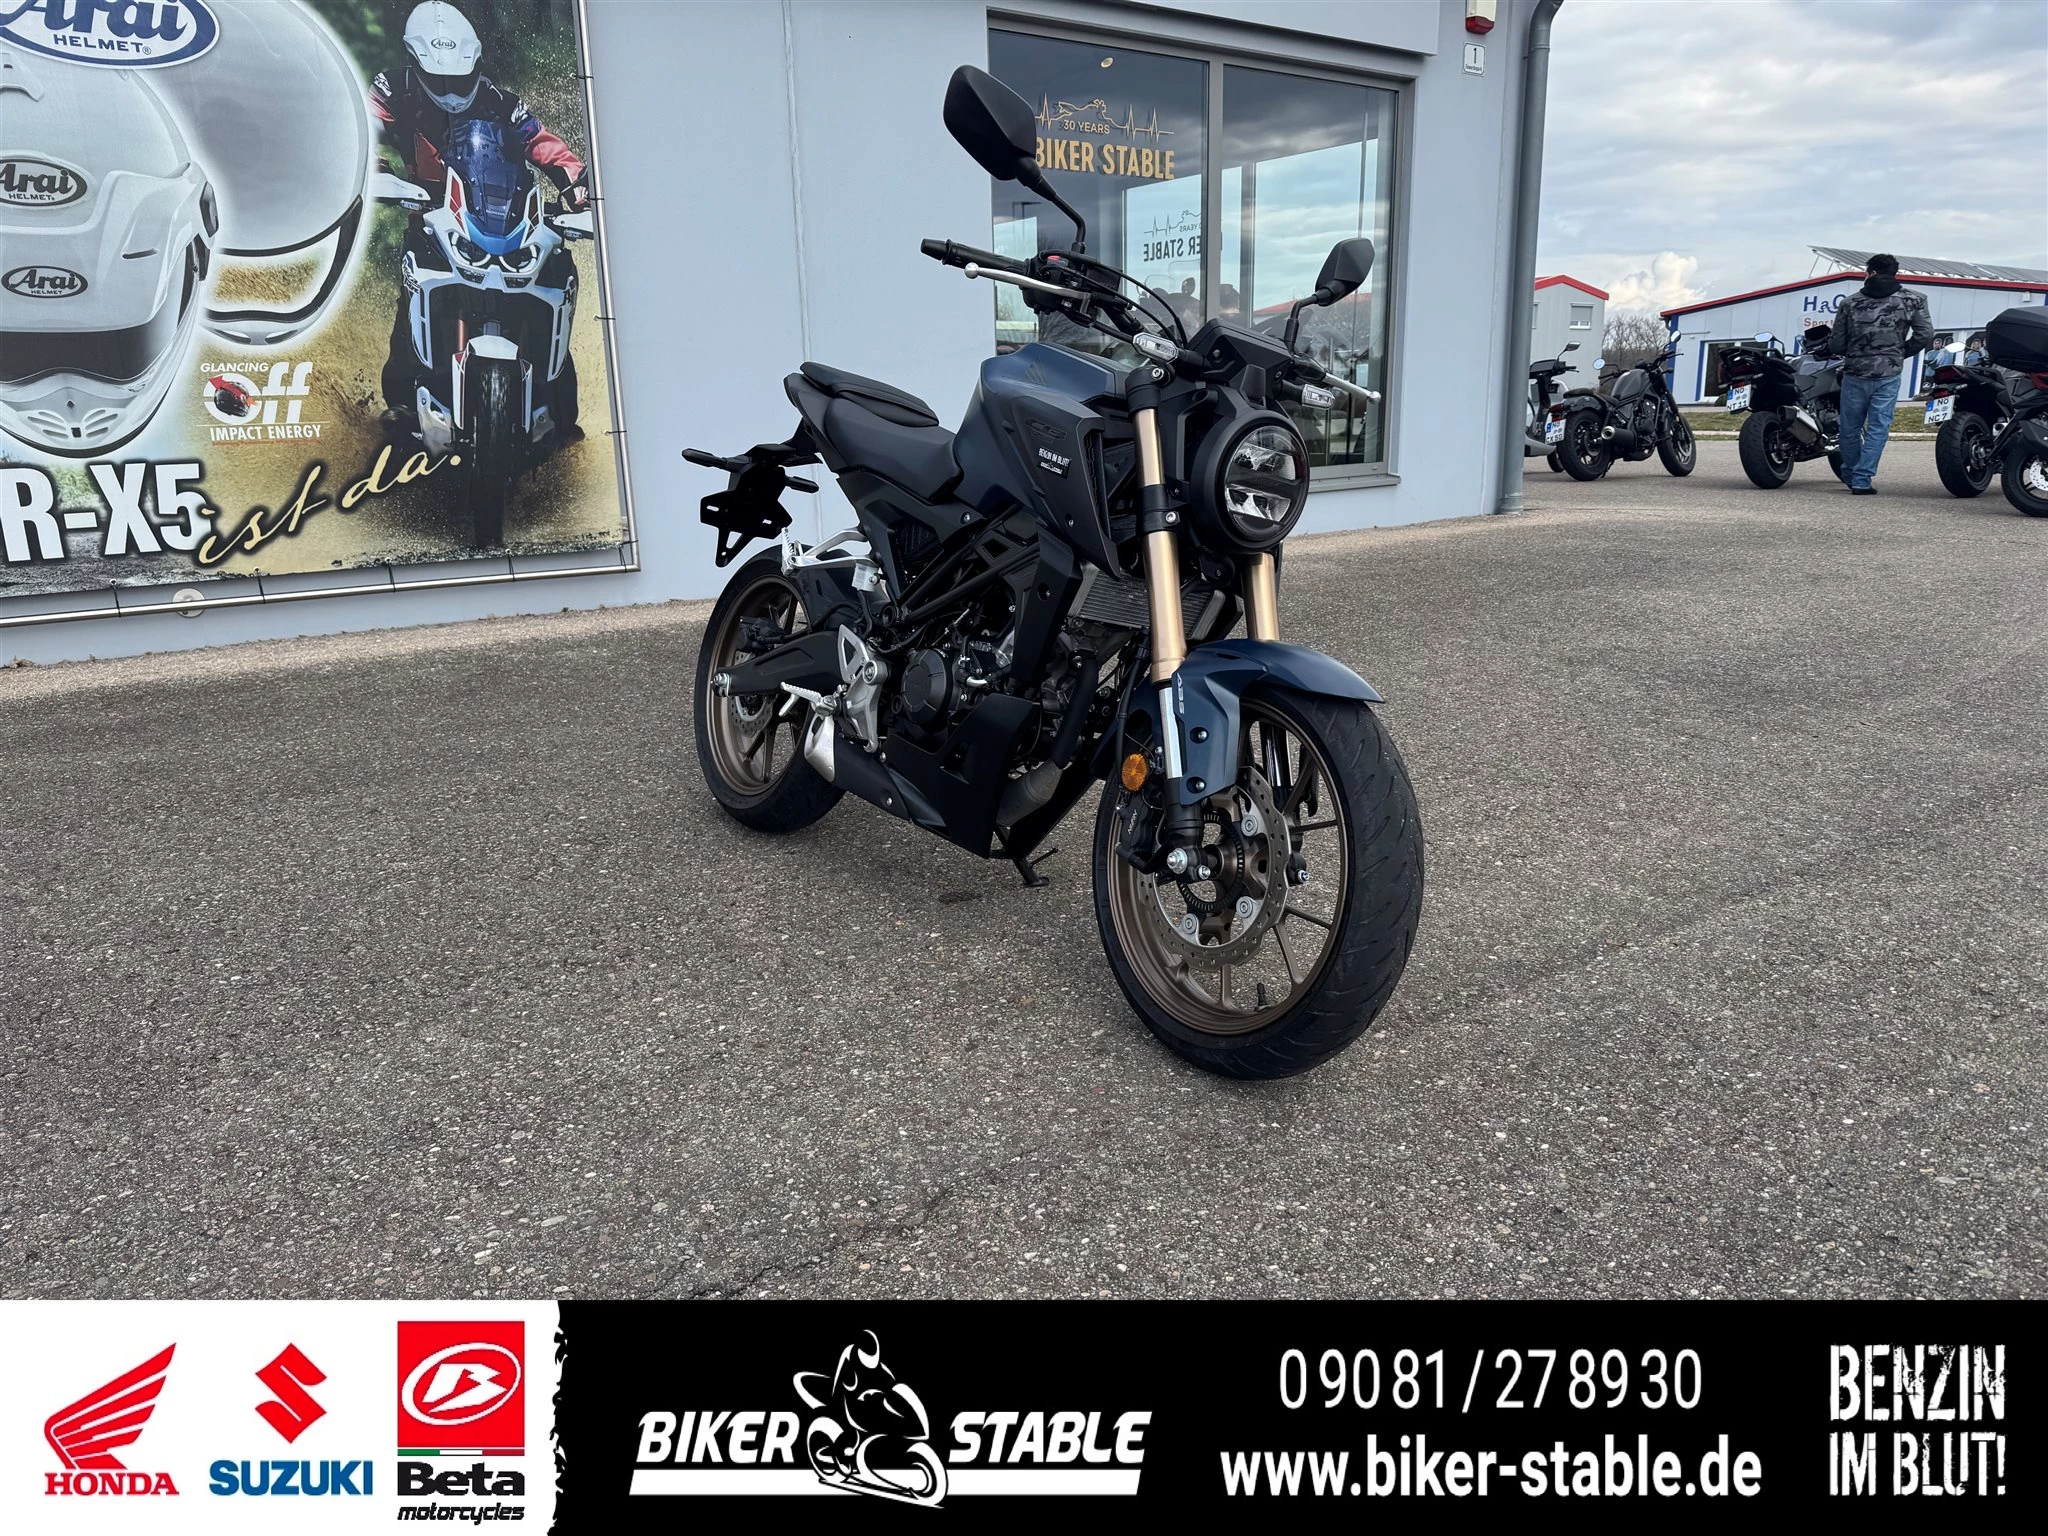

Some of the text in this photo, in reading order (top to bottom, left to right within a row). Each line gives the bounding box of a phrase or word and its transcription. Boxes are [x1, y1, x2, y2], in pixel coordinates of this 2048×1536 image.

[1473, 47, 1477, 64] 1
[1063, 119, 1110, 135] 30 YEARS
[1036, 136, 1175, 180] BIKER STABLE
[0, 163, 74, 195] Arai
[9, 269, 78, 290] Arai
[200, 362, 269, 373] GLANCING
[210, 424, 321, 440] IMPACT ENERGY
[199, 467, 326, 564] ist
[1176, 672, 1185, 715] ABS
